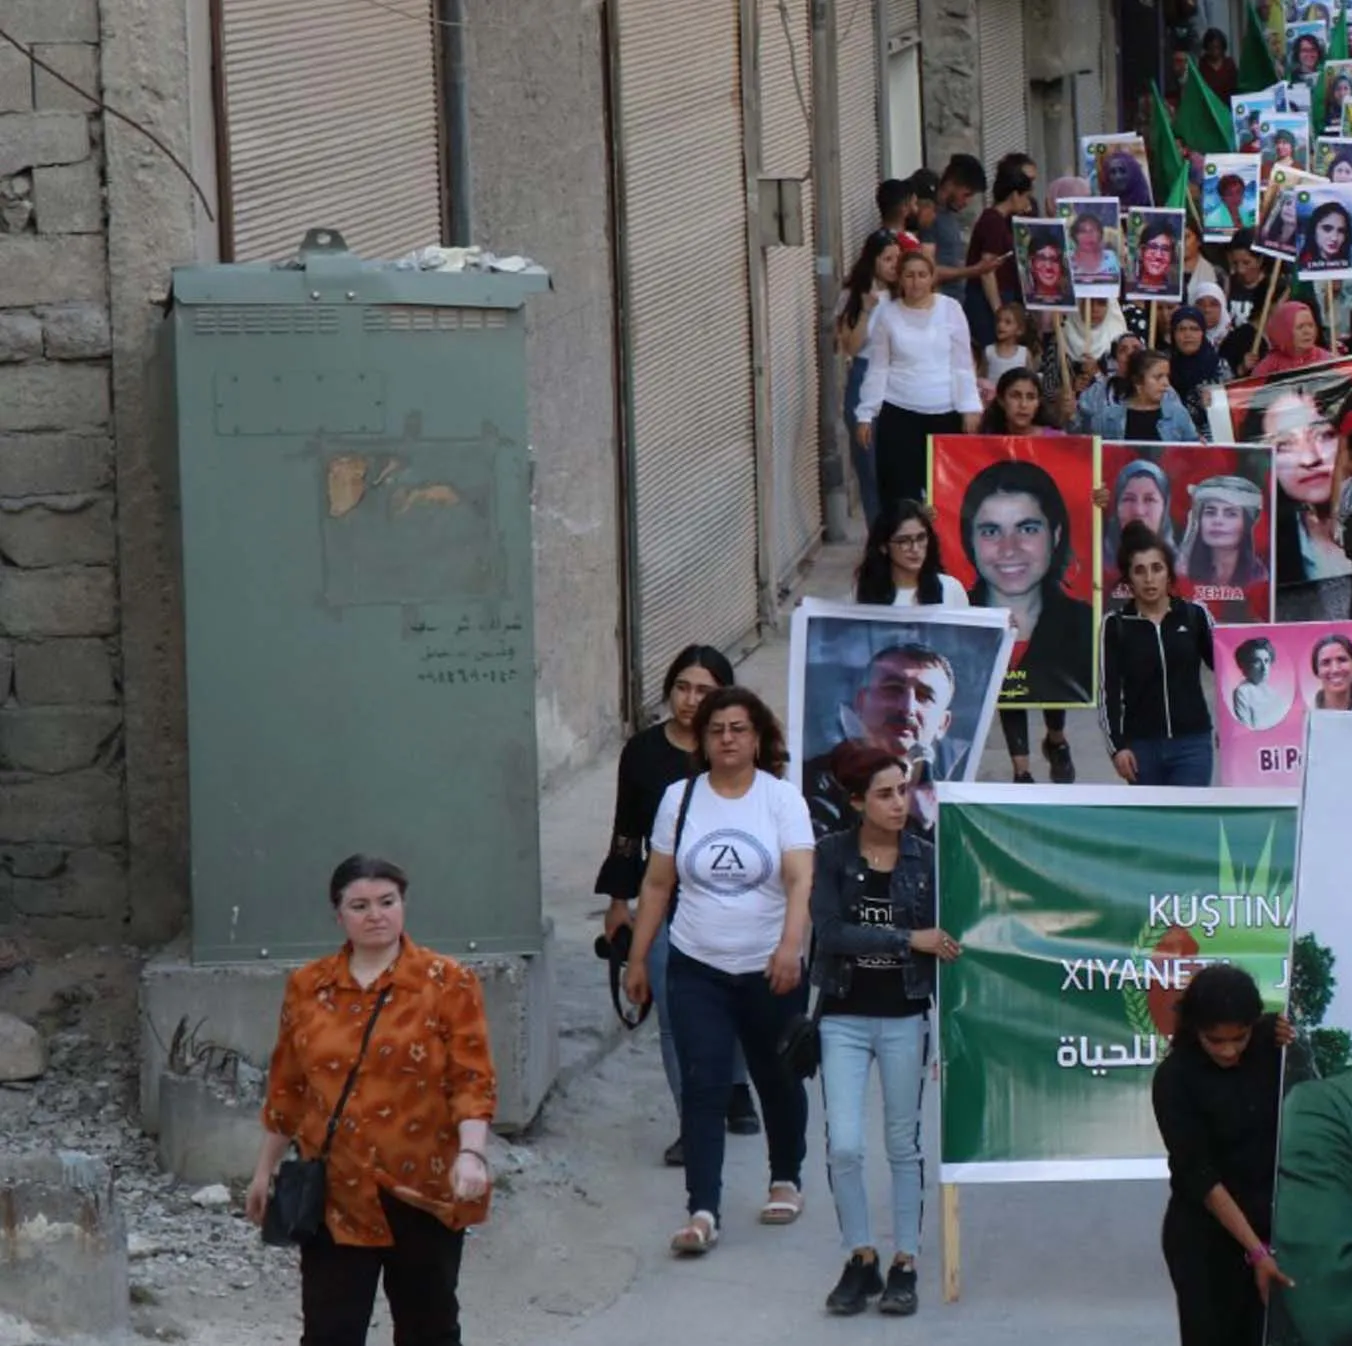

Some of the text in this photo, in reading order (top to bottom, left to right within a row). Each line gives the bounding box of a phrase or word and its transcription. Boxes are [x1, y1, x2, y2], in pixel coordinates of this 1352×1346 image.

[1259, 748, 1279, 771] Bi
[1060, 958, 1231, 990] XIYANE
[1056, 1033, 1157, 1076] للحياة
